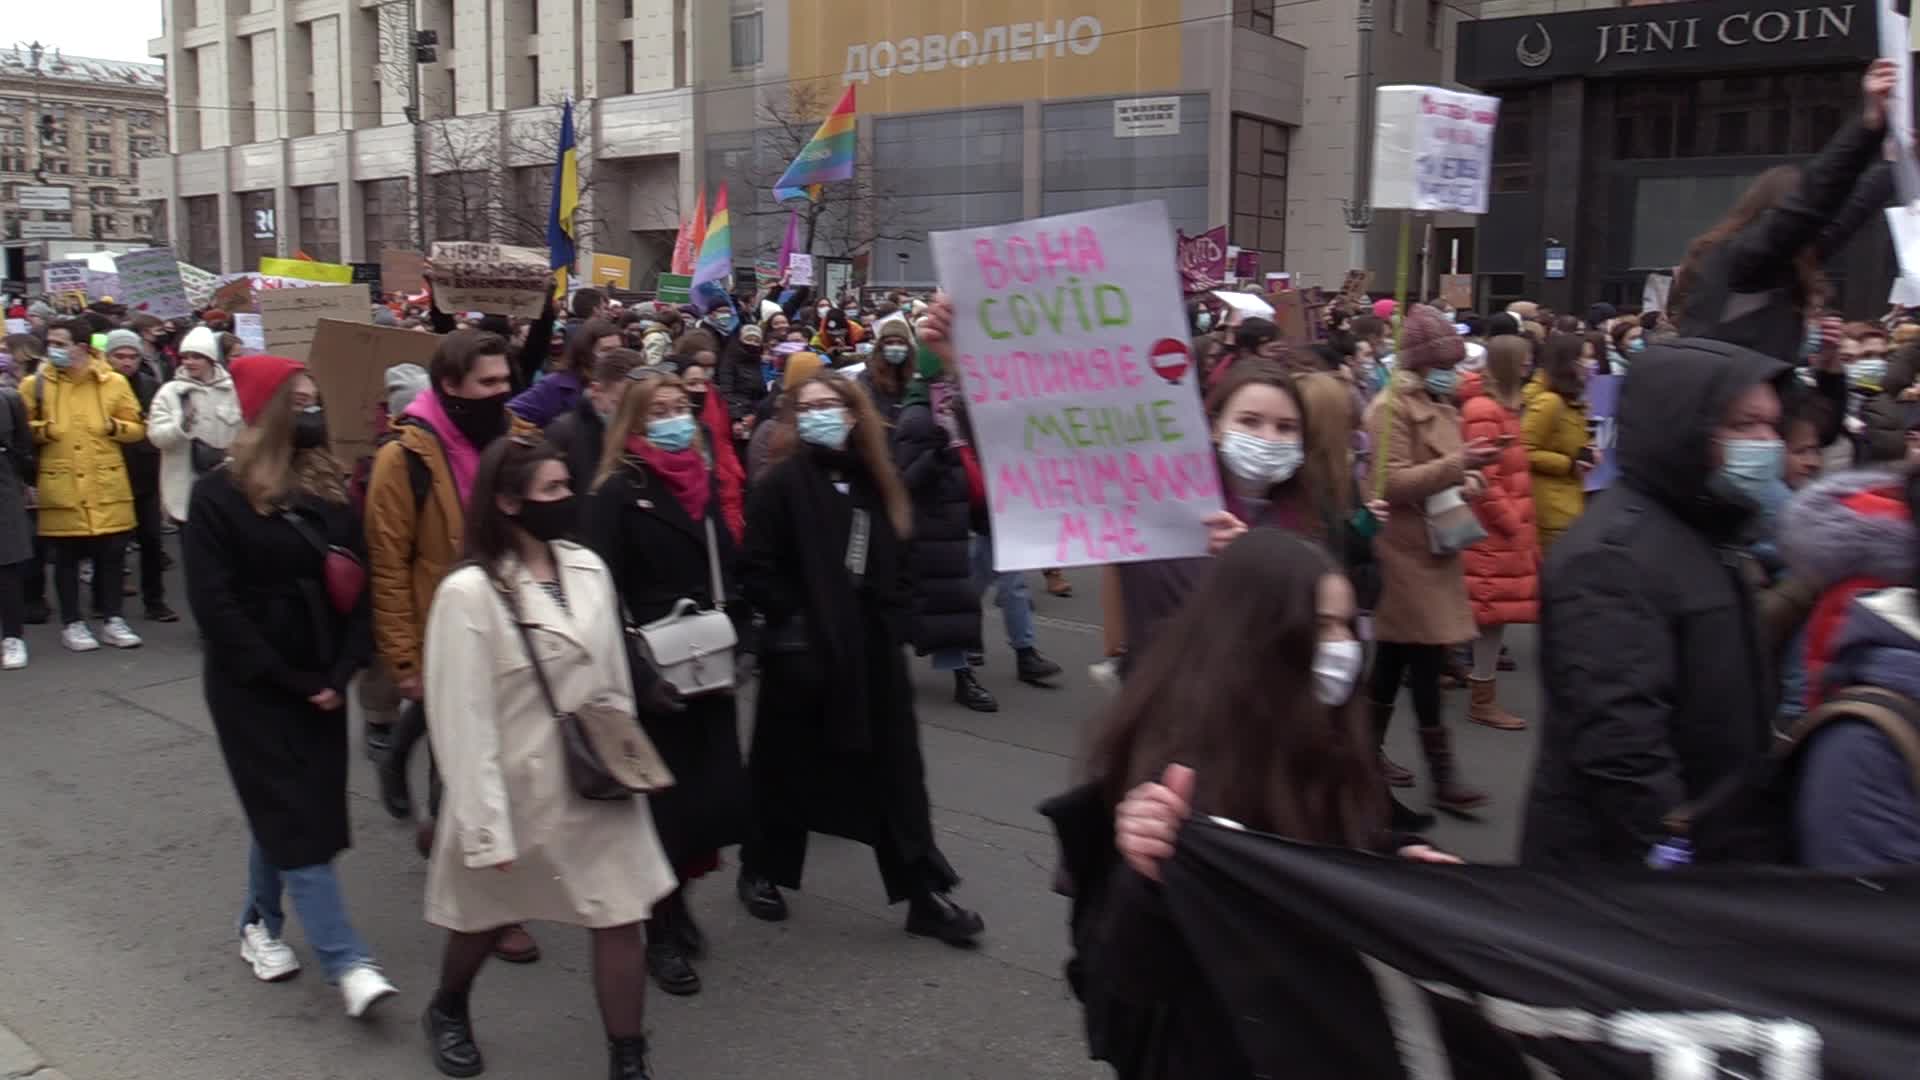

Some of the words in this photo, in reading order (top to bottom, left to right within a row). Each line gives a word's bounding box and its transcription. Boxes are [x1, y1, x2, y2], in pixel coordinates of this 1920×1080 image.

[841, 15, 1102, 86] ДОЗВОЛЕНО
[1595, 18, 1700, 63] JENI
[1717, 4, 1855, 46] COIN
[973, 225, 1105, 290] ВОНА
[1024, 399, 1185, 450] МЕНШЕ
